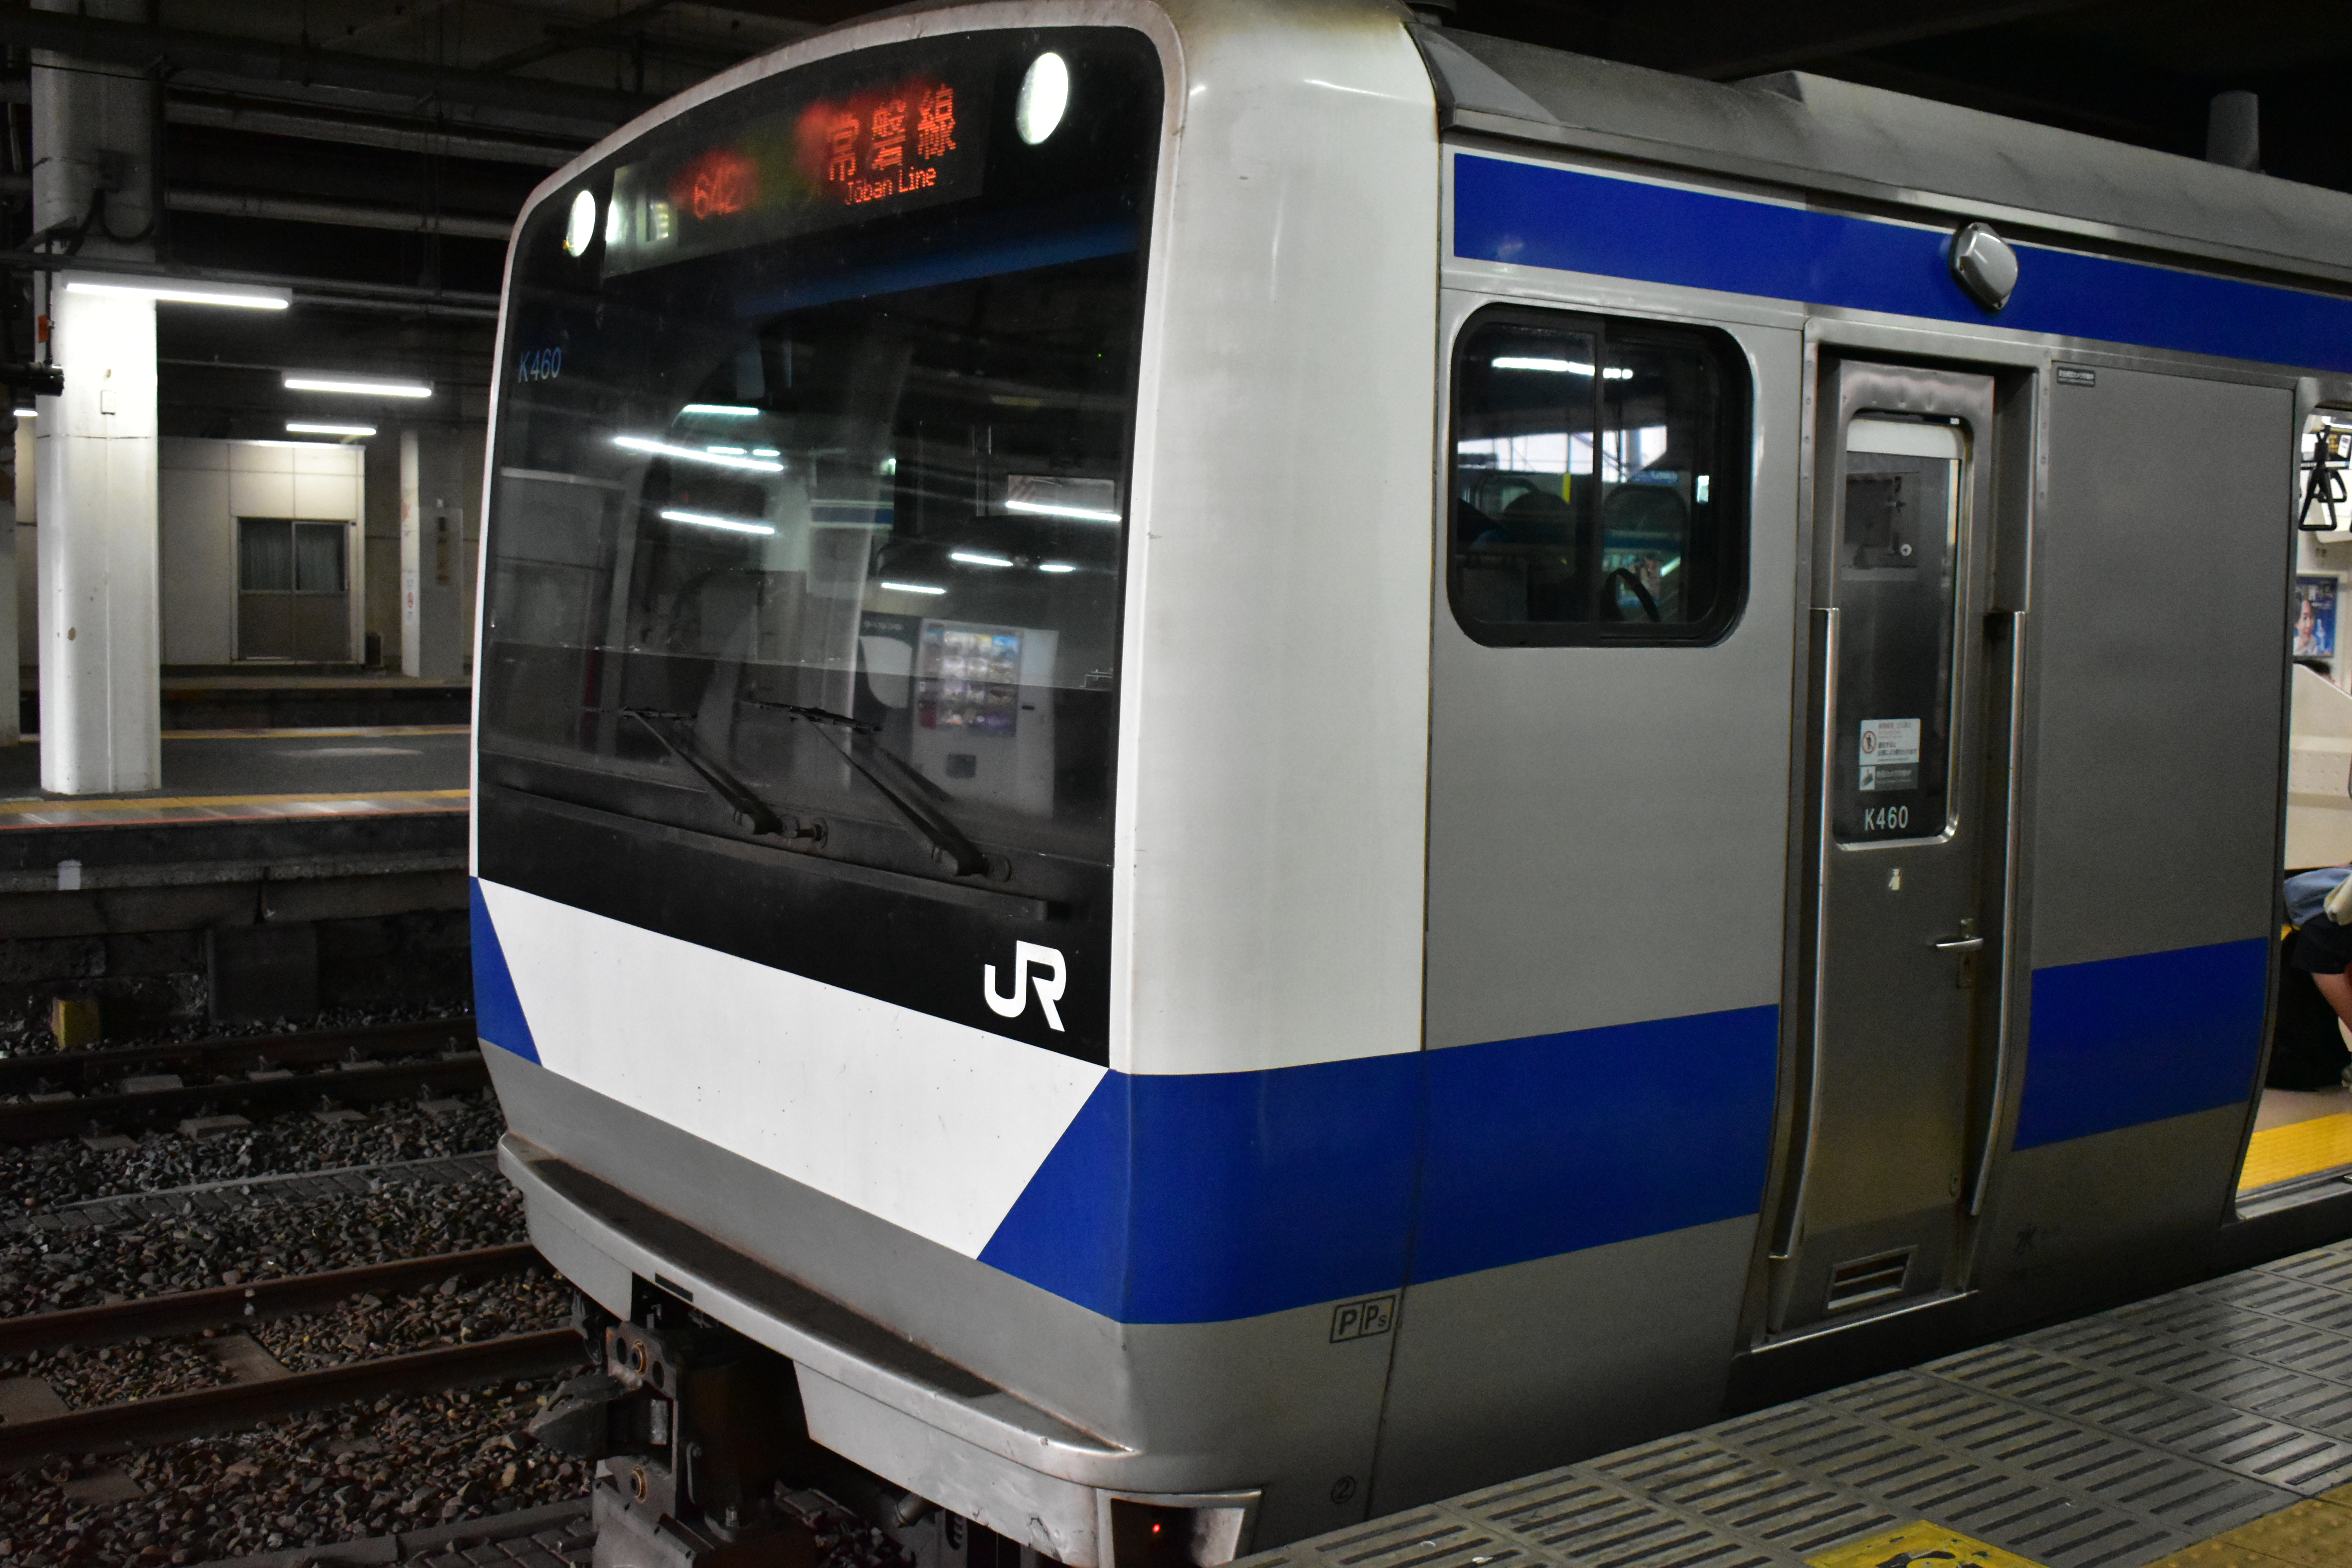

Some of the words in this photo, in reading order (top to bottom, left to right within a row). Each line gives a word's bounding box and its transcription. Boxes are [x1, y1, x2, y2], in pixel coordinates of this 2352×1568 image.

[898, 167, 937, 193] Line
[518, 347, 561, 383] K460
[1864, 805, 1909, 831] K460
[984, 940, 1067, 1032] JR
